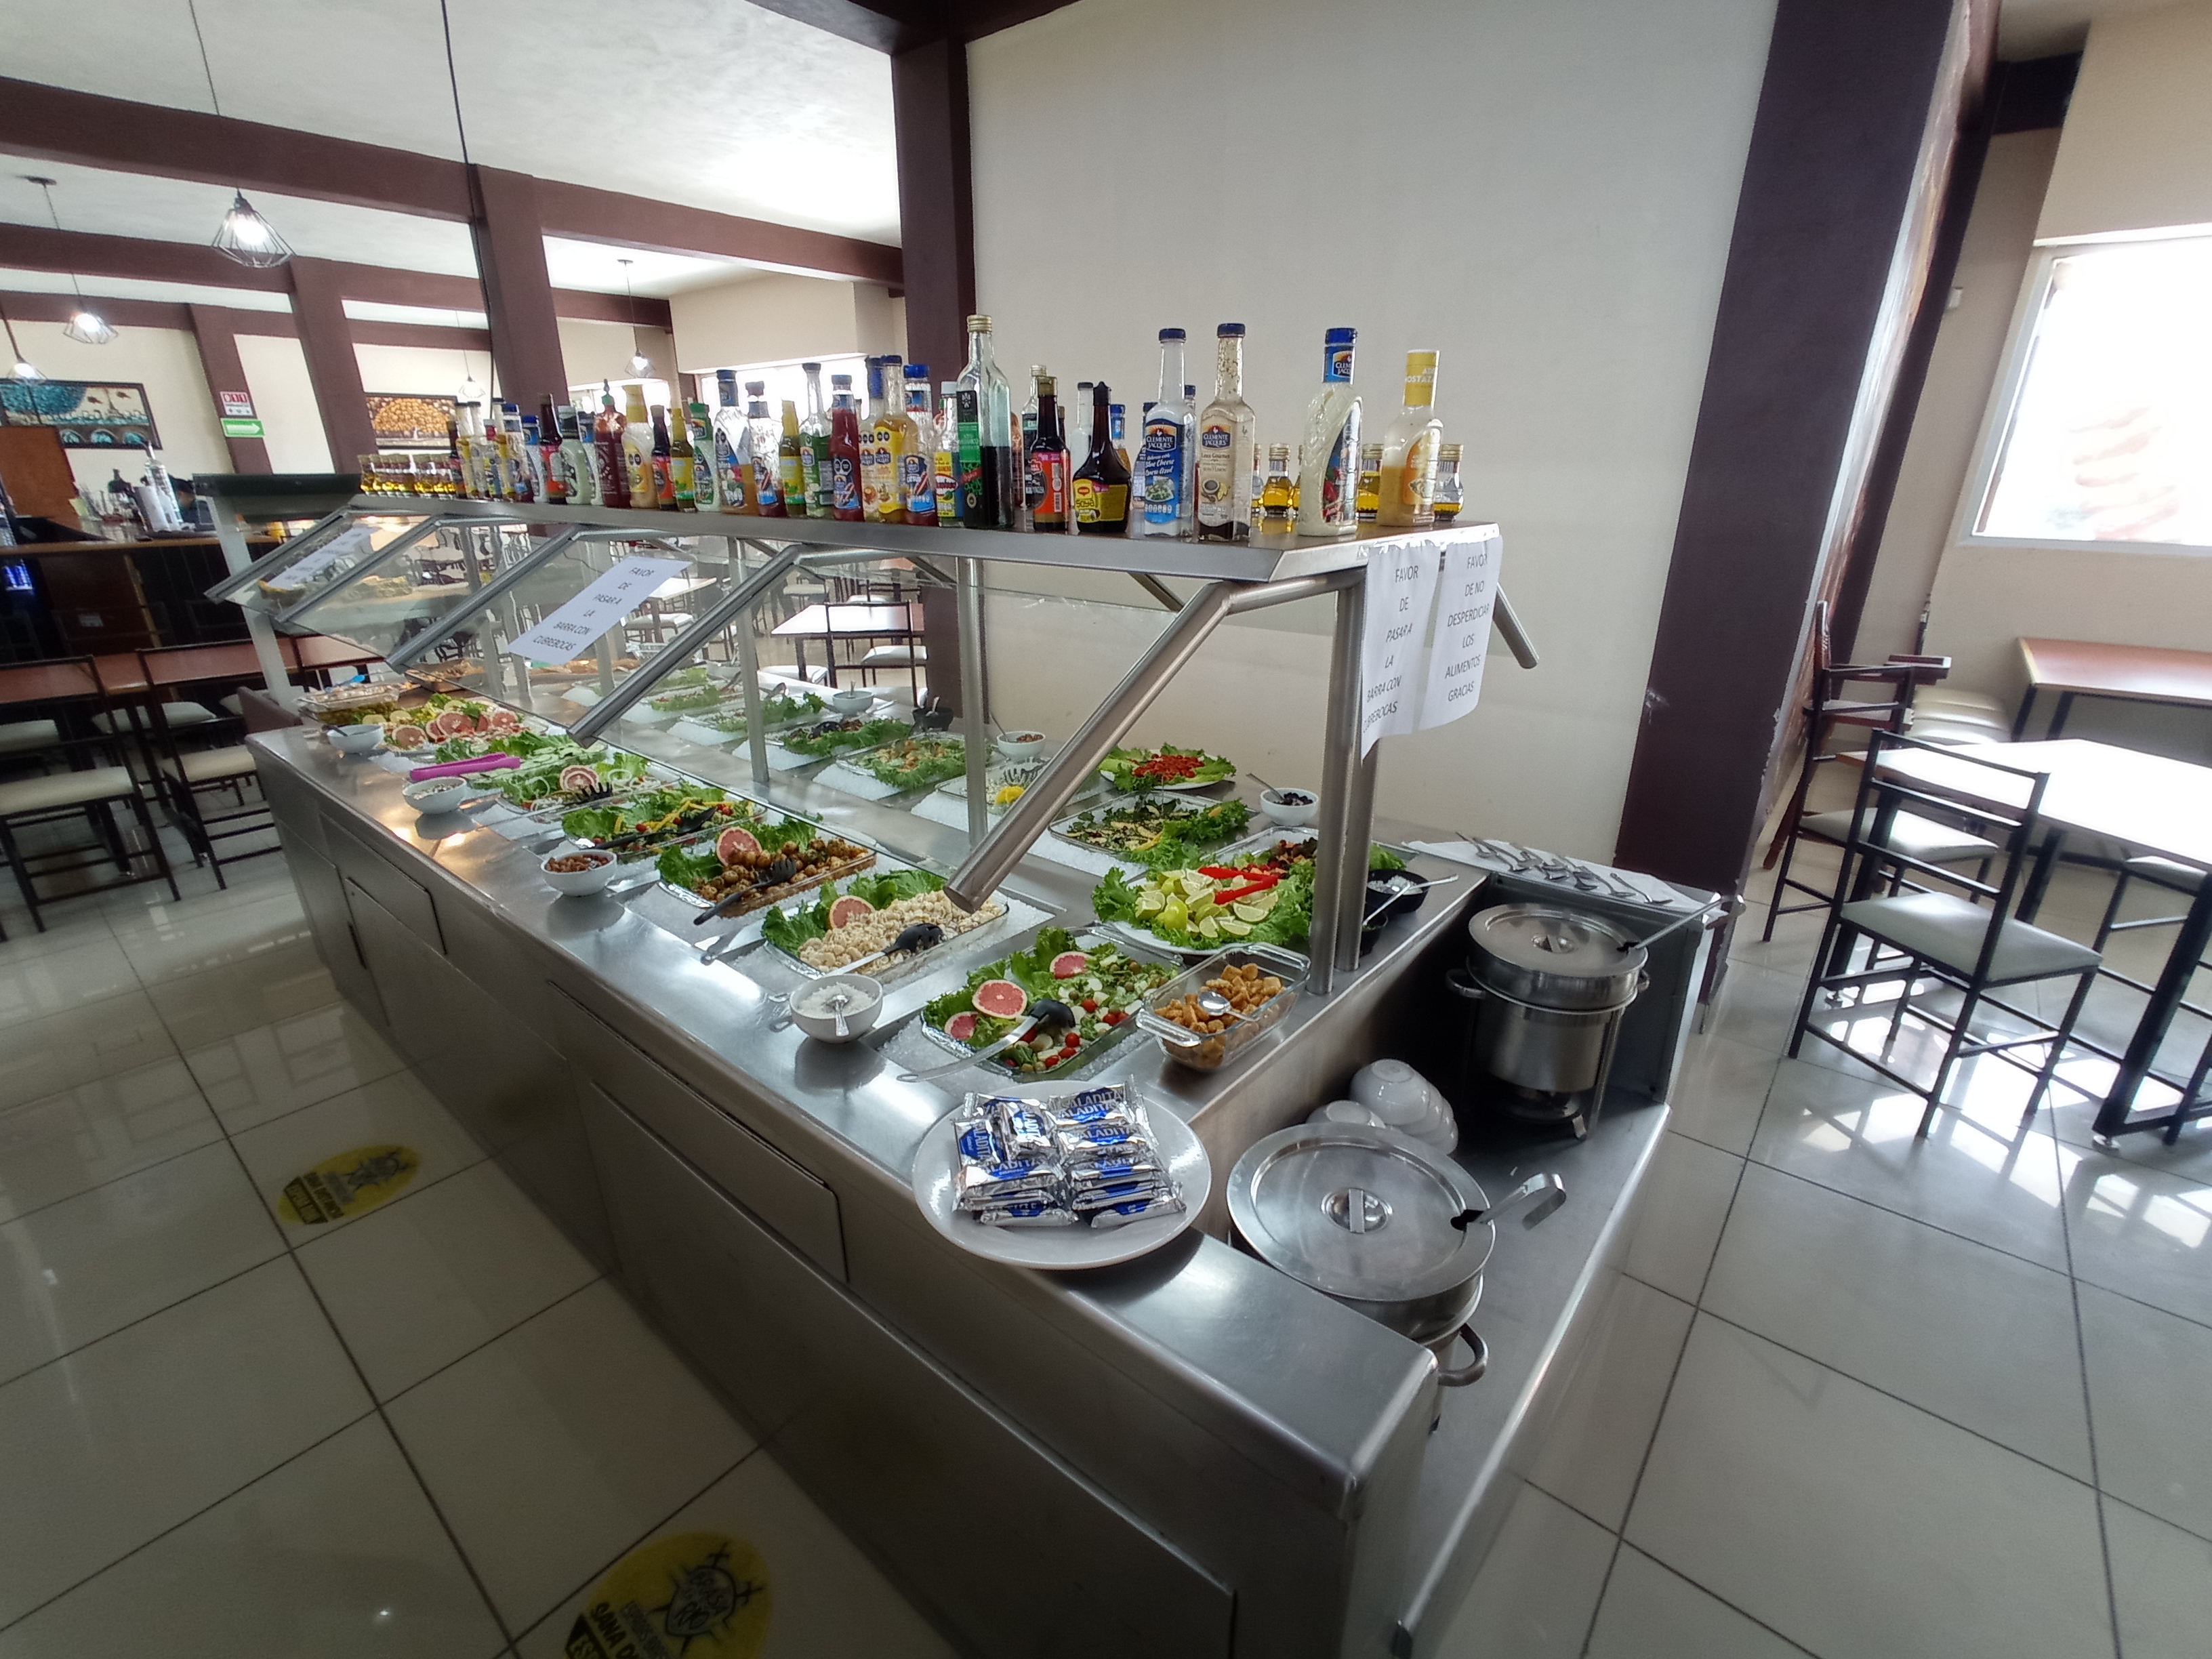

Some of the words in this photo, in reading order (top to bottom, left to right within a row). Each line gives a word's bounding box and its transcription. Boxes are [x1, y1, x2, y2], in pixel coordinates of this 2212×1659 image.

[1147, 442, 1171, 450] JACQUES
[1467, 554, 1487, 569] FAVOR
[630, 567, 655, 577] FAVOR
[1395, 565, 1419, 583] FAVOR
[1465, 583, 1474, 596] DE
[1475, 581, 1484, 594] NO
[1399, 597, 1408, 612] DE
[1448, 603, 1490, 628] DESPERDICIAR
[1386, 625, 1407, 642] PASAR
[1407, 623, 1412, 634] A
[1462, 634, 1475, 648] LOS
[1385, 655, 1394, 668] LA
[1445, 655, 1481, 678] ALIMENTOS
[1367, 682, 1386, 703] BARRA
[1386, 676, 1401, 693] CON
[1448, 681, 1475, 701] GRACIAS
